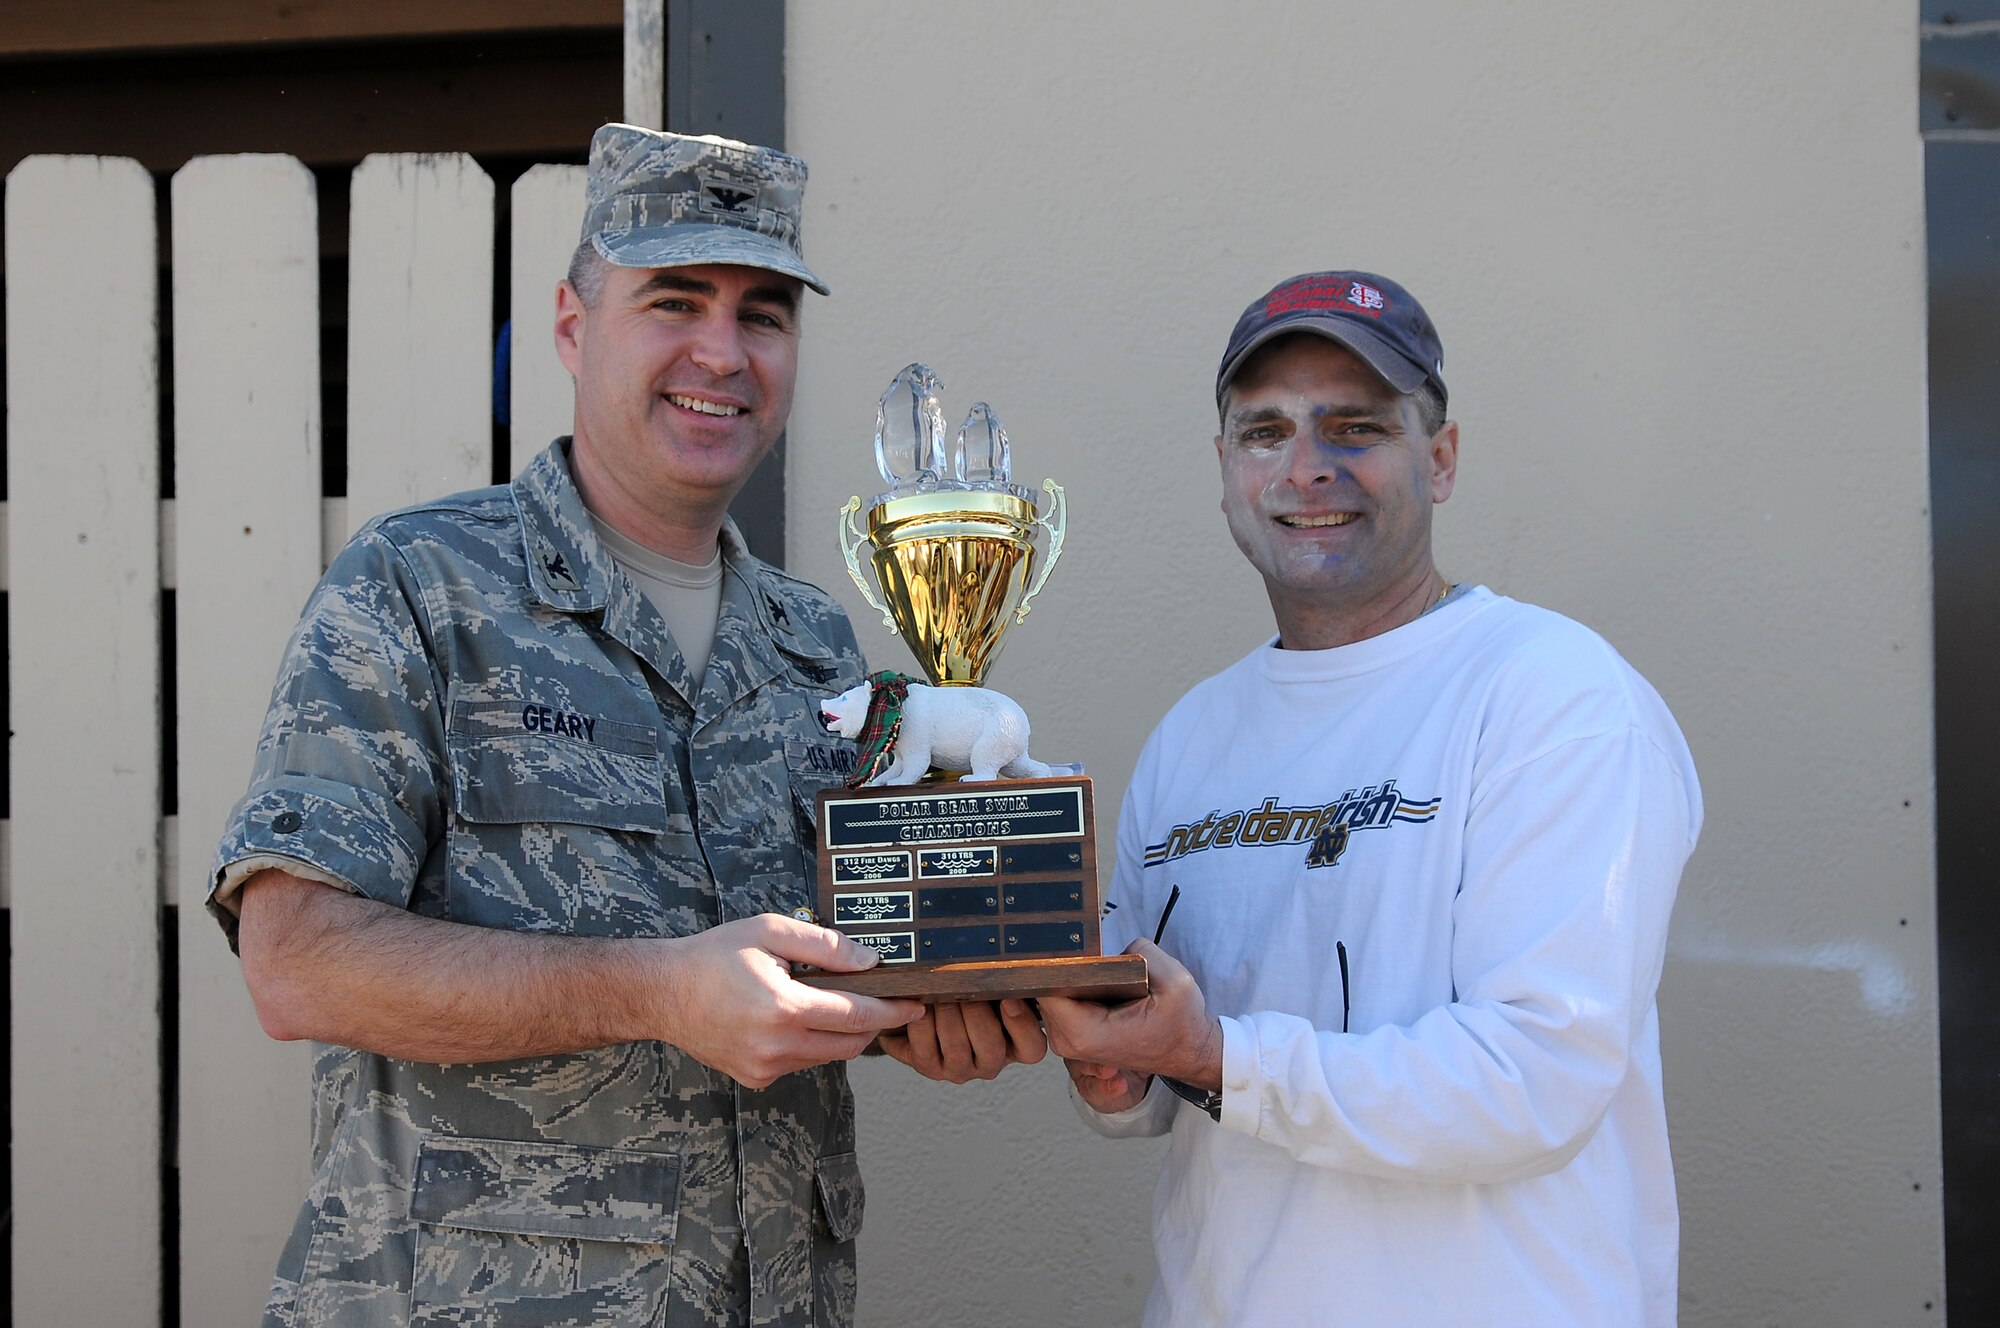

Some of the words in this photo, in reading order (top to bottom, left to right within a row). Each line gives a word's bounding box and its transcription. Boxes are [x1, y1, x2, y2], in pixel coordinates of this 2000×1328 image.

[522, 704, 596, 742] GEARY
[831, 748, 851, 772] AIR
[879, 801, 931, 818] POLAR
[938, 799, 979, 815] BEAR
[985, 796, 1029, 812] SWIM
[900, 821, 1011, 840] CHAMPIONS
[1164, 809, 1241, 862] notre
[844, 857, 859, 866] 312
[941, 852, 957, 860] 316
[959, 851, 974, 859] TRS
[857, 897, 873, 905] 316
[874, 896, 889, 904] TRS
[859, 937, 875, 945] 316
[876, 936, 891, 944] TRS
